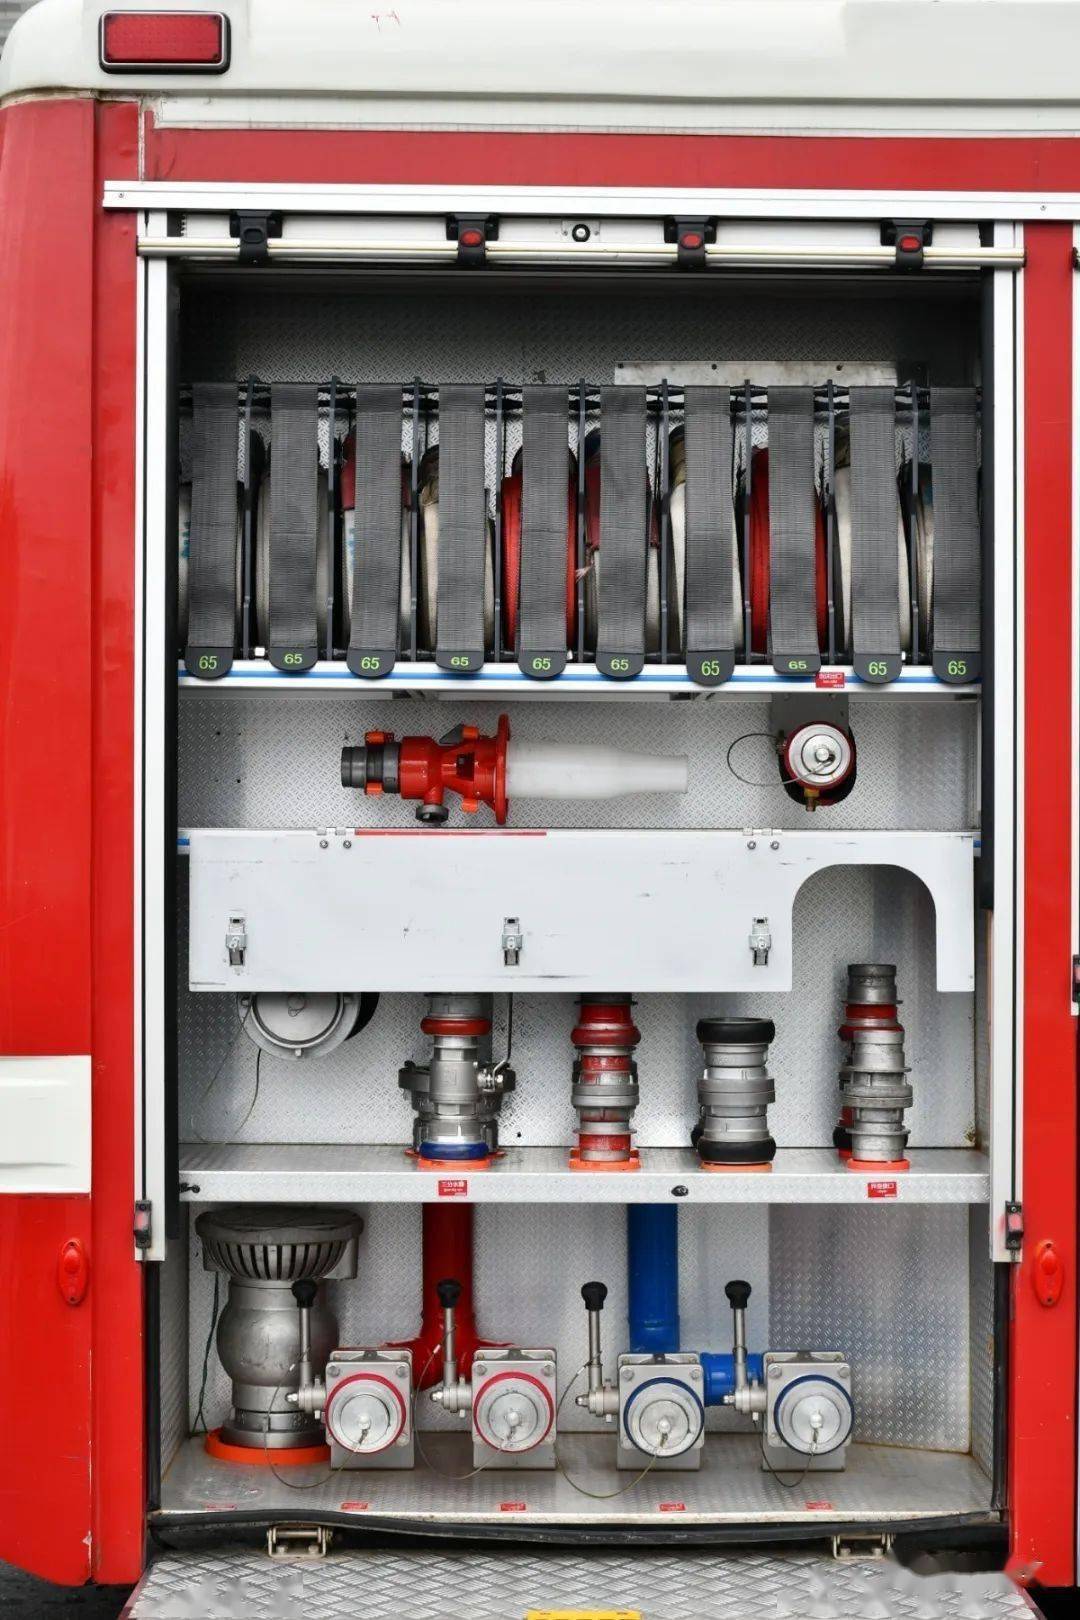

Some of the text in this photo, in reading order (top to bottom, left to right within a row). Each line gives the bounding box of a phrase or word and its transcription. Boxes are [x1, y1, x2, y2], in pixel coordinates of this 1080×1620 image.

[199, 656, 217, 670] 65
[285, 652, 302, 665] 65
[361, 657, 379, 670] 65
[451, 656, 469, 667] 65
[533, 658, 551, 671] 65
[788, 660, 806, 669] 65
[611, 659, 629, 672] 65
[701, 659, 720, 675] 65
[868, 663, 886, 676] 65
[947, 661, 966, 676] 65
